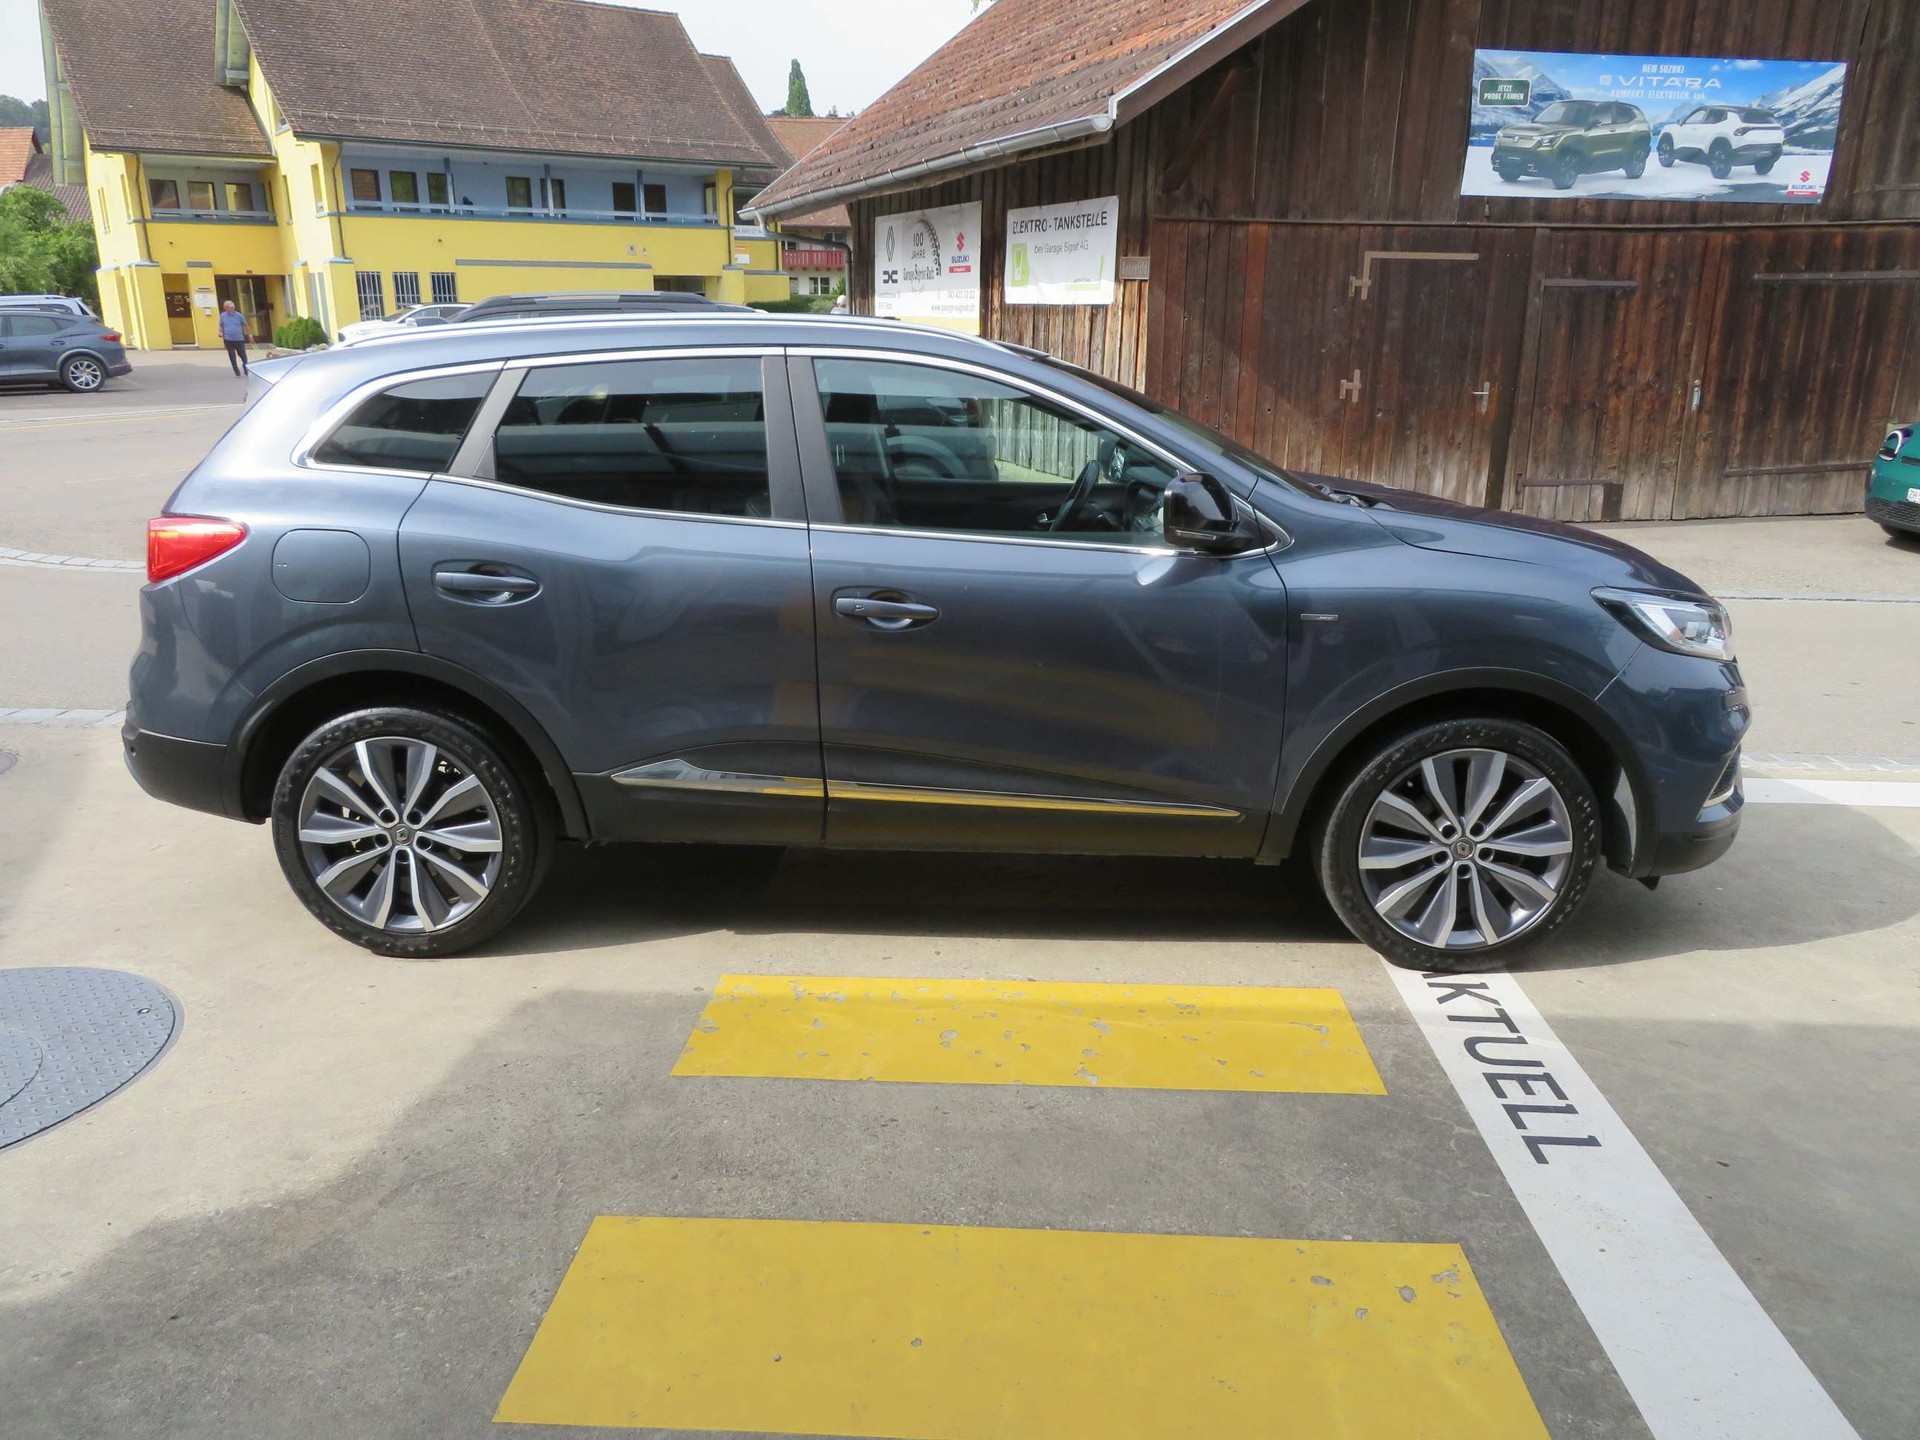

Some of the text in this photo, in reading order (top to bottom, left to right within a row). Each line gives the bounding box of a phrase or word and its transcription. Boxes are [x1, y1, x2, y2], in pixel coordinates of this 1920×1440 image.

[1660, 64, 1685, 74] SUZUKI
[1618, 75, 1721, 89] VITARA
[1012, 218, 1048, 235] ELEKTRO
[1053, 211, 1108, 232] TANKSTELLE
[913, 232, 924, 247] 100
[951, 255, 970, 264] SUZUKI
[1421, 972, 1602, 1164] KTUELL
